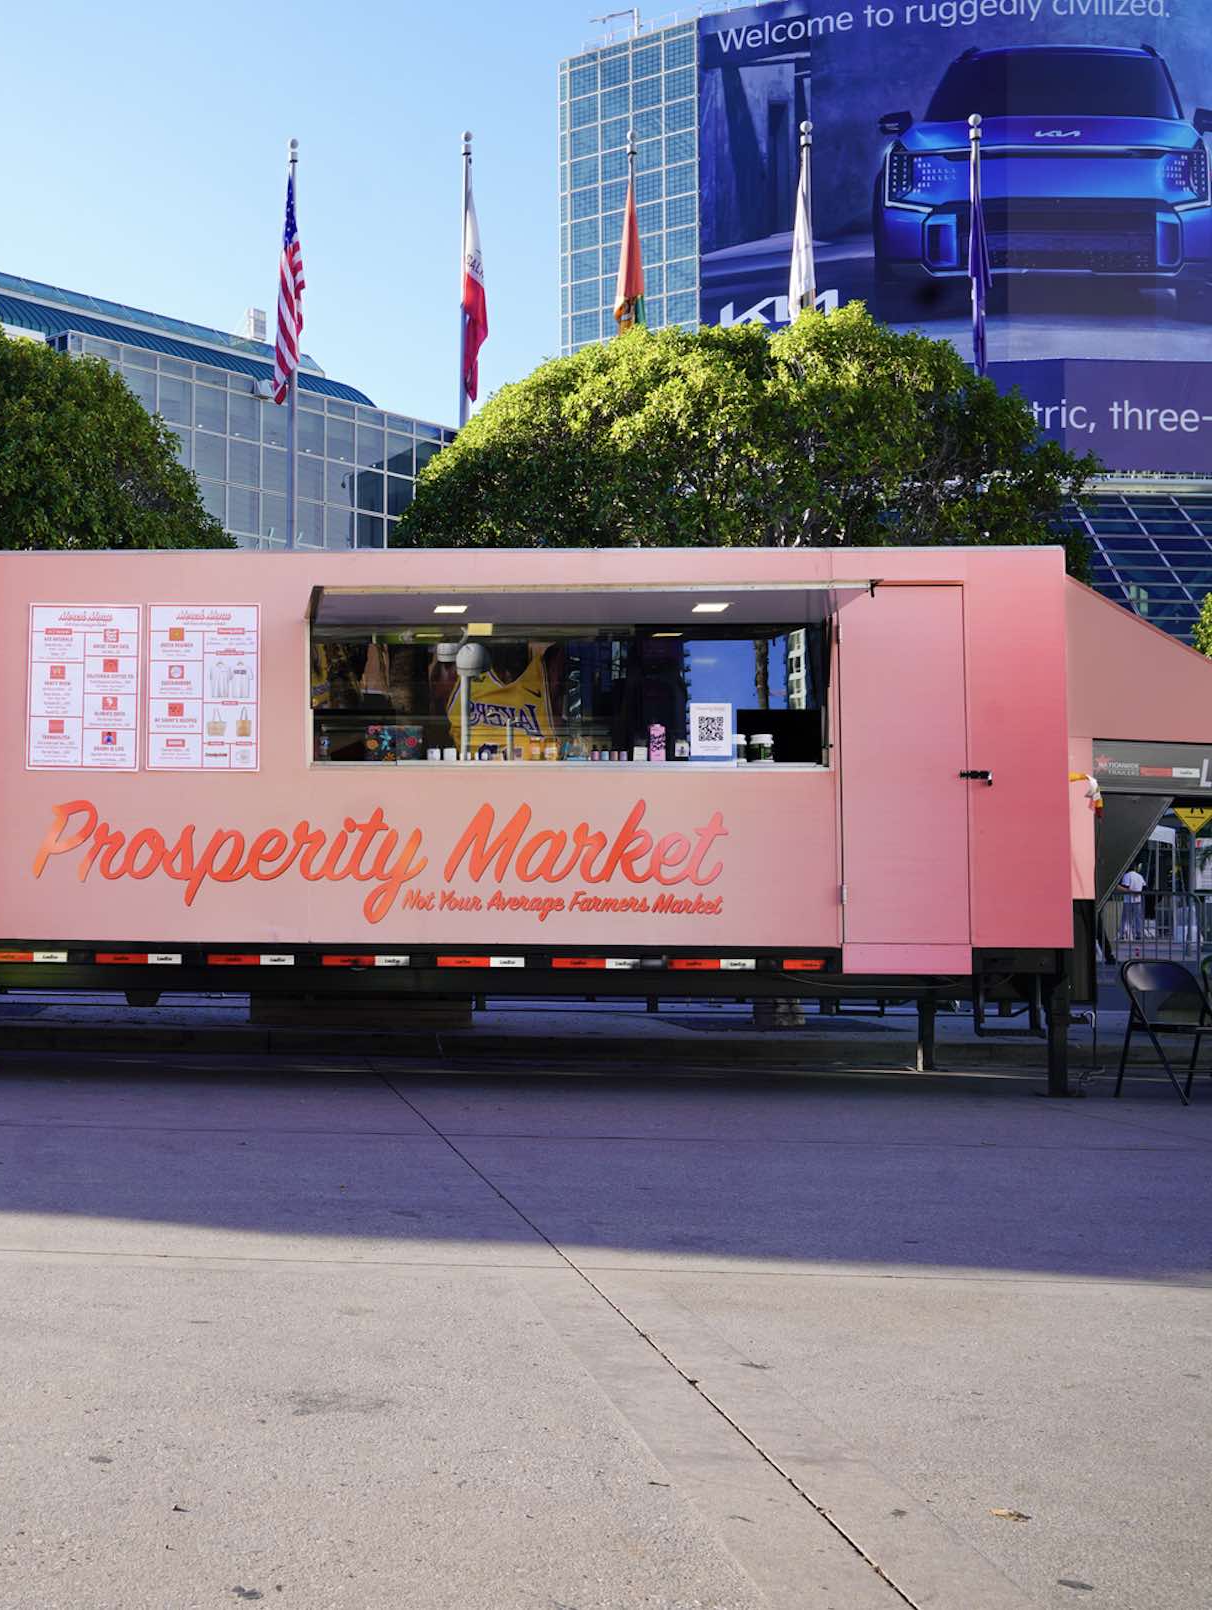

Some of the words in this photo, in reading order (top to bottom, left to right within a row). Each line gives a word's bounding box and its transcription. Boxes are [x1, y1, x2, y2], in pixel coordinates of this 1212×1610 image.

[717, 11, 854, 53] Welcome
[863, 5, 894, 28] to
[905, 0, 1040, 28] ruggedly
[1052, 0, 1171, 18] civilized.
[1022, 399, 1097, 434] tric,
[1108, 399, 1212, 432] three-
[33, 799, 427, 924] Prosperity
[444, 799, 728, 887] Market
[401, 888, 435, 911] Not
[438, 889, 482, 912] Your
[486, 889, 565, 921] Average
[567, 890, 650, 913] Farmers
[651, 892, 724, 915] Market
